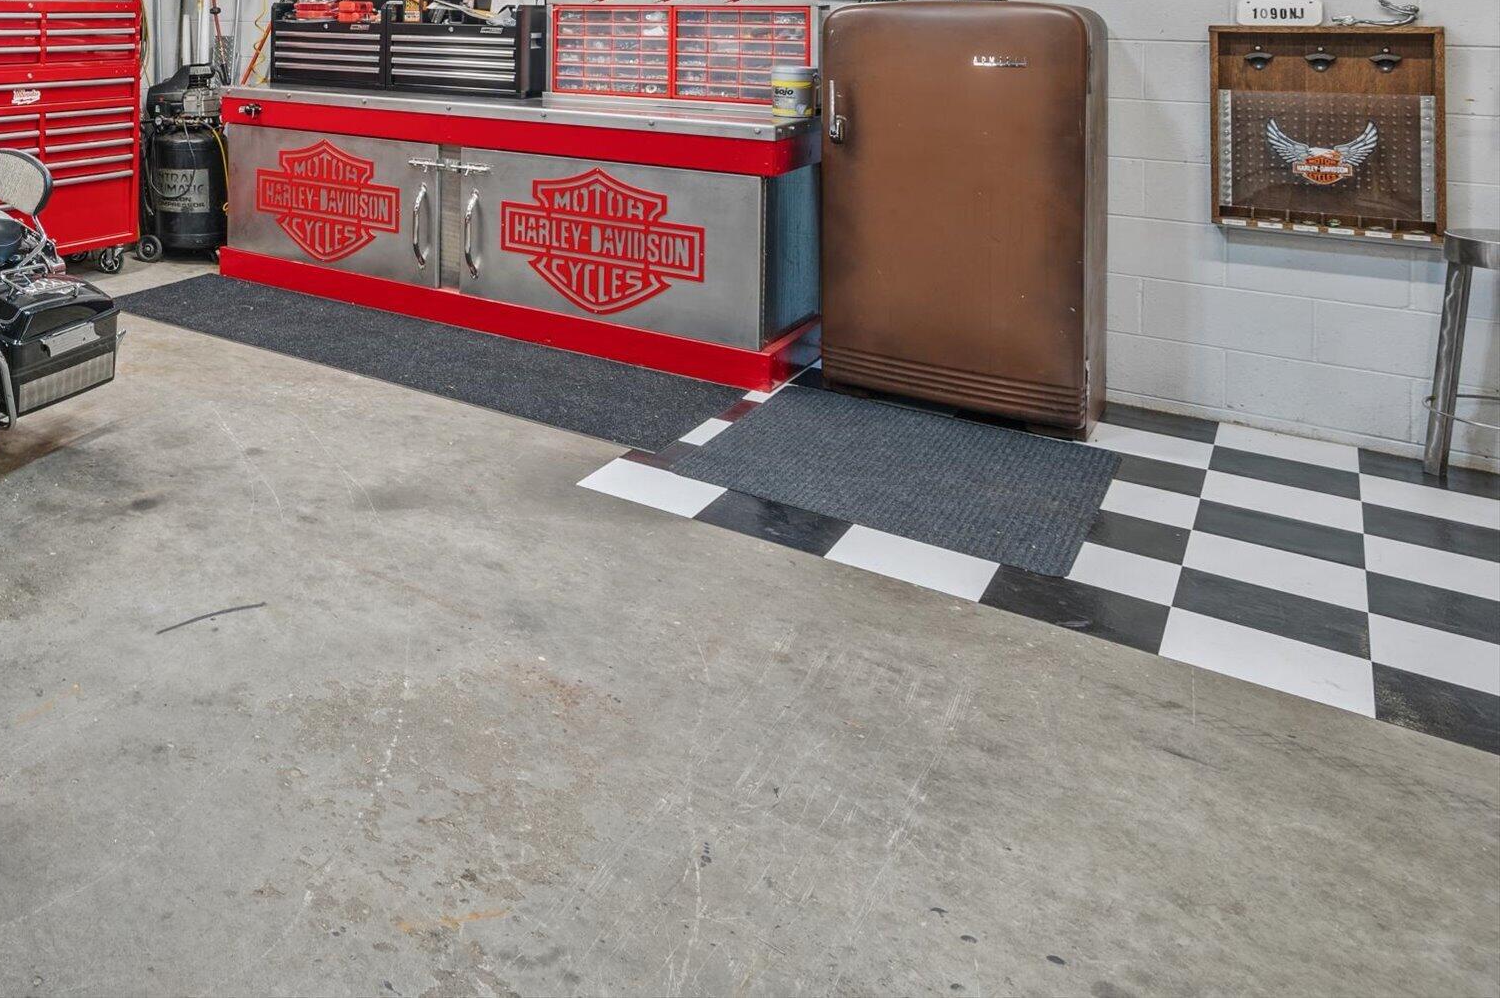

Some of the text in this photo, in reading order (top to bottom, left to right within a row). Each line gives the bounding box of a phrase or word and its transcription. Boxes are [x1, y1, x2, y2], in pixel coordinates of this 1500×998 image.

[1251, 7, 1305, 20] 1090NJ
[293, 153, 358, 183] MOTOR
[265, 180, 389, 222] HARLEY-DAVIDSON
[553, 183, 645, 221] MOTOR
[292, 215, 357, 254] CYCLES
[513, 214, 691, 268] HARLEY-DAVIDSON
[551, 257, 644, 304] CYCLES
